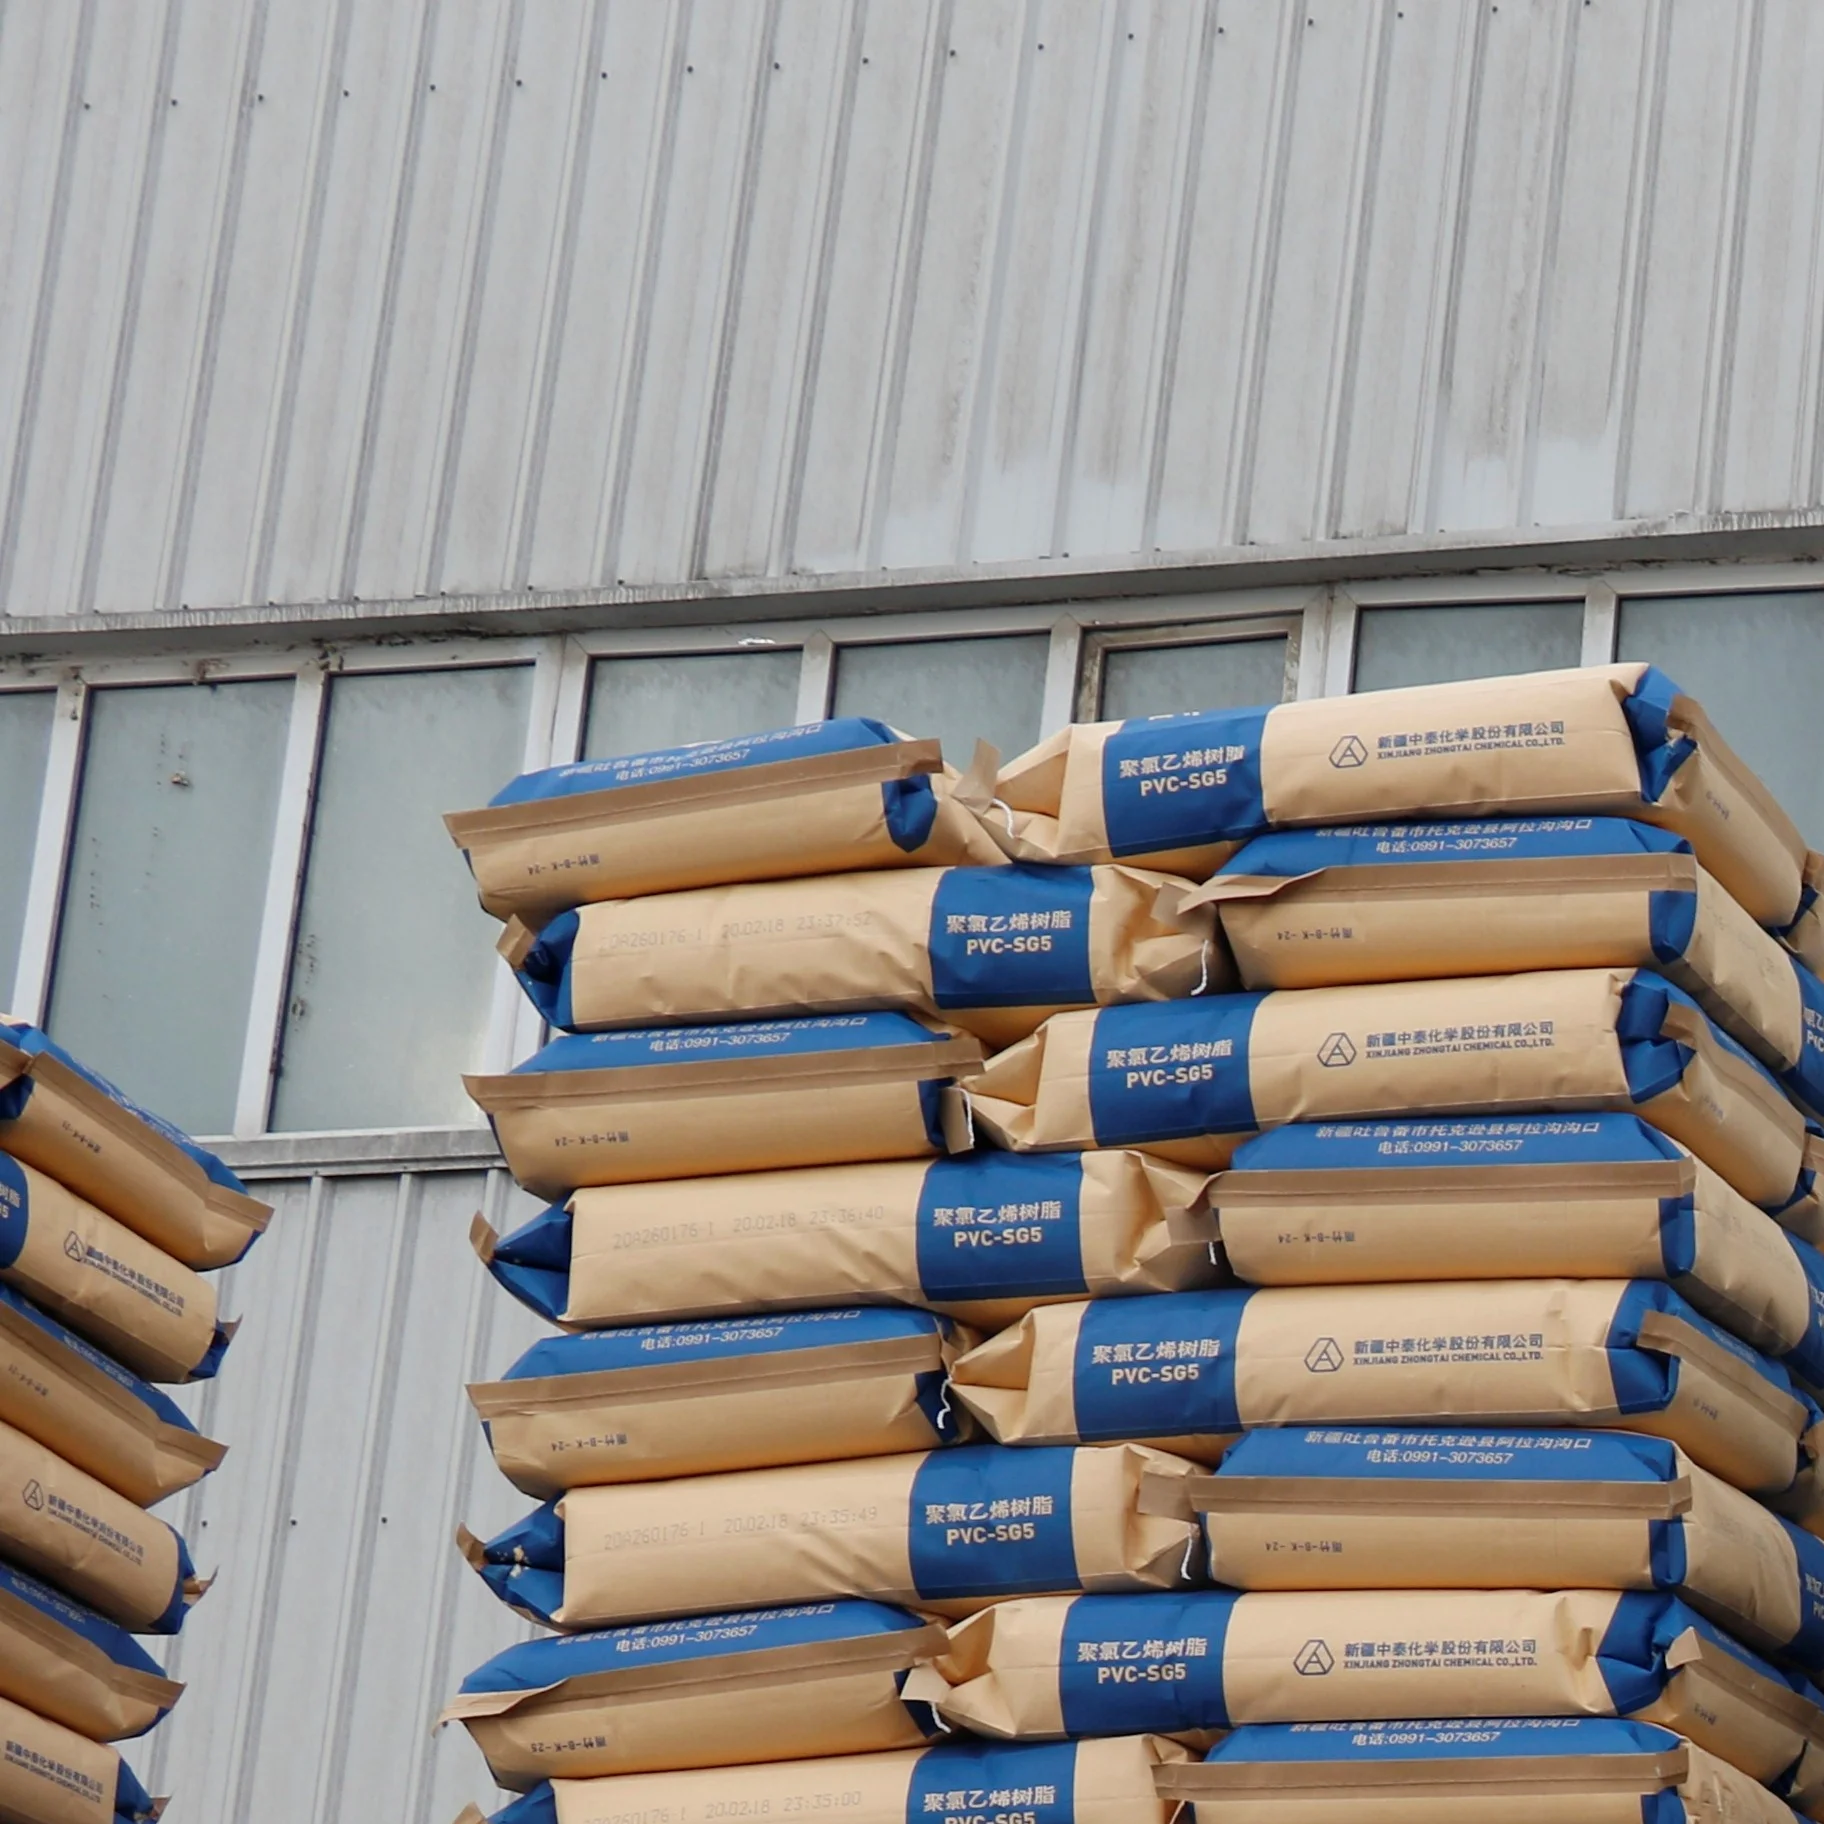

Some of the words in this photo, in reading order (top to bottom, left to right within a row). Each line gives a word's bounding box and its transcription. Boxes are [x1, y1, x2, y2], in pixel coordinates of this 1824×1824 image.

[1377, 720, 1564, 747] 新疆中泰化学股份有限公司
[1377, 747, 1422, 759] XINJIANG
[1424, 743, 1472, 755] ZHONGTAI
[1473, 739, 1524, 751] CHEMICAL
[1140, 768, 1226, 796] PVC-SG5
[721, 918, 785, 941] 20.02.18
[947, 910, 1071, 933] 聚氯乙烯树脂
[967, 935, 1051, 955] PVC-SG5
[1365, 1020, 1553, 1047] 新疆中泰化学股份有限公司
[1107, 1038, 1232, 1068] 聚氯乙烯树脂
[1365, 1047, 1411, 1059] XINJIANG
[1412, 1043, 1461, 1056] ZHONGTAI
[1462, 1040, 1512, 1052] CHEMICAL
[1126, 1063, 1212, 1088] PVC-SG5
[1315, 1122, 1600, 1138] 新疆吐鲁番市托克逊县阿拉沟沟口
[732, 1211, 798, 1235] 20.02.18
[933, 1200, 1061, 1226] 聚氯乙烯树脂
[954, 1226, 1042, 1247] PVC-SG5
[1092, 1338, 1220, 1364] 聚氯乙烯树脂
[1354, 1333, 1543, 1355] 新疆中泰化学股份有限公司
[1353, 1355, 1399, 1365] XINJIANG
[1400, 1353, 1452, 1364] ZHONGTAI
[1451, 1352, 1504, 1362] CHEMICAL
[1112, 1363, 1199, 1385] PVC-SG5
[1304, 1431, 1591, 1450] 新疆吐鲁番市托克逊县阿拉沟沟口
[926, 1495, 1053, 1524] 聚氯乙烯树脂
[723, 1512, 790, 1537] 20.02.18
[946, 1522, 1034, 1546] PVC-SG5
[1077, 1637, 1207, 1662] 聚氯乙烯树脂
[1344, 1639, 1536, 1658] 新疆中泰化学股份有限公司
[1098, 1662, 1186, 1684] PVC-SG5
[1343, 1659, 1390, 1669] XINJIANG
[1391, 1658, 1444, 1668] ZHONGTAI
[1443, 1657, 1494, 1667] CHEMICAL
[704, 1798, 773, 1819] 20.02.18
[924, 1785, 1055, 1812] 聚氯乙烯树脂
